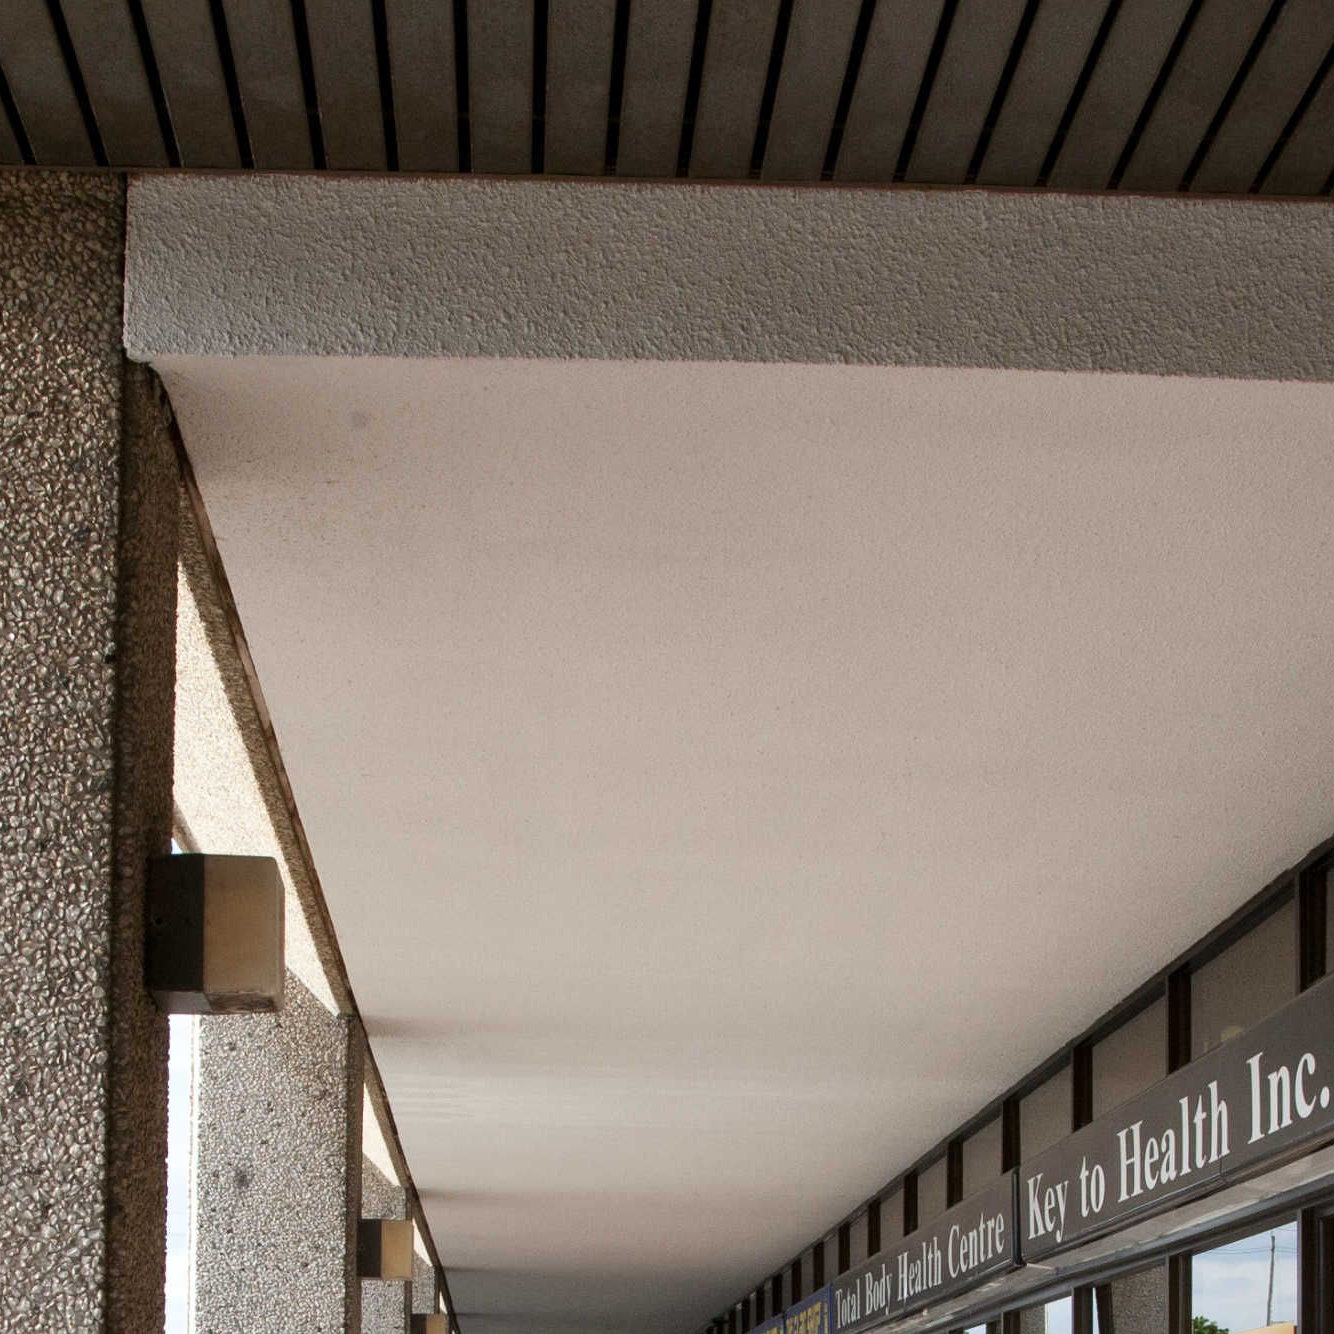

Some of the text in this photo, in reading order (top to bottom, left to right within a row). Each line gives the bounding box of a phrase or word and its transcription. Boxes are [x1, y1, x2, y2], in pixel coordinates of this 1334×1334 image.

[1026, 1174, 1070, 1245] Key
[1079, 1164, 1106, 1218] to
[1116, 1080, 1229, 1203] Health
[1246, 1051, 1331, 1144] Inc.
[835, 1278, 861, 1329] Total
[865, 1263, 893, 1316] Body
[897, 1237, 942, 1302] Health
[948, 1211, 1005, 1278] Centre
